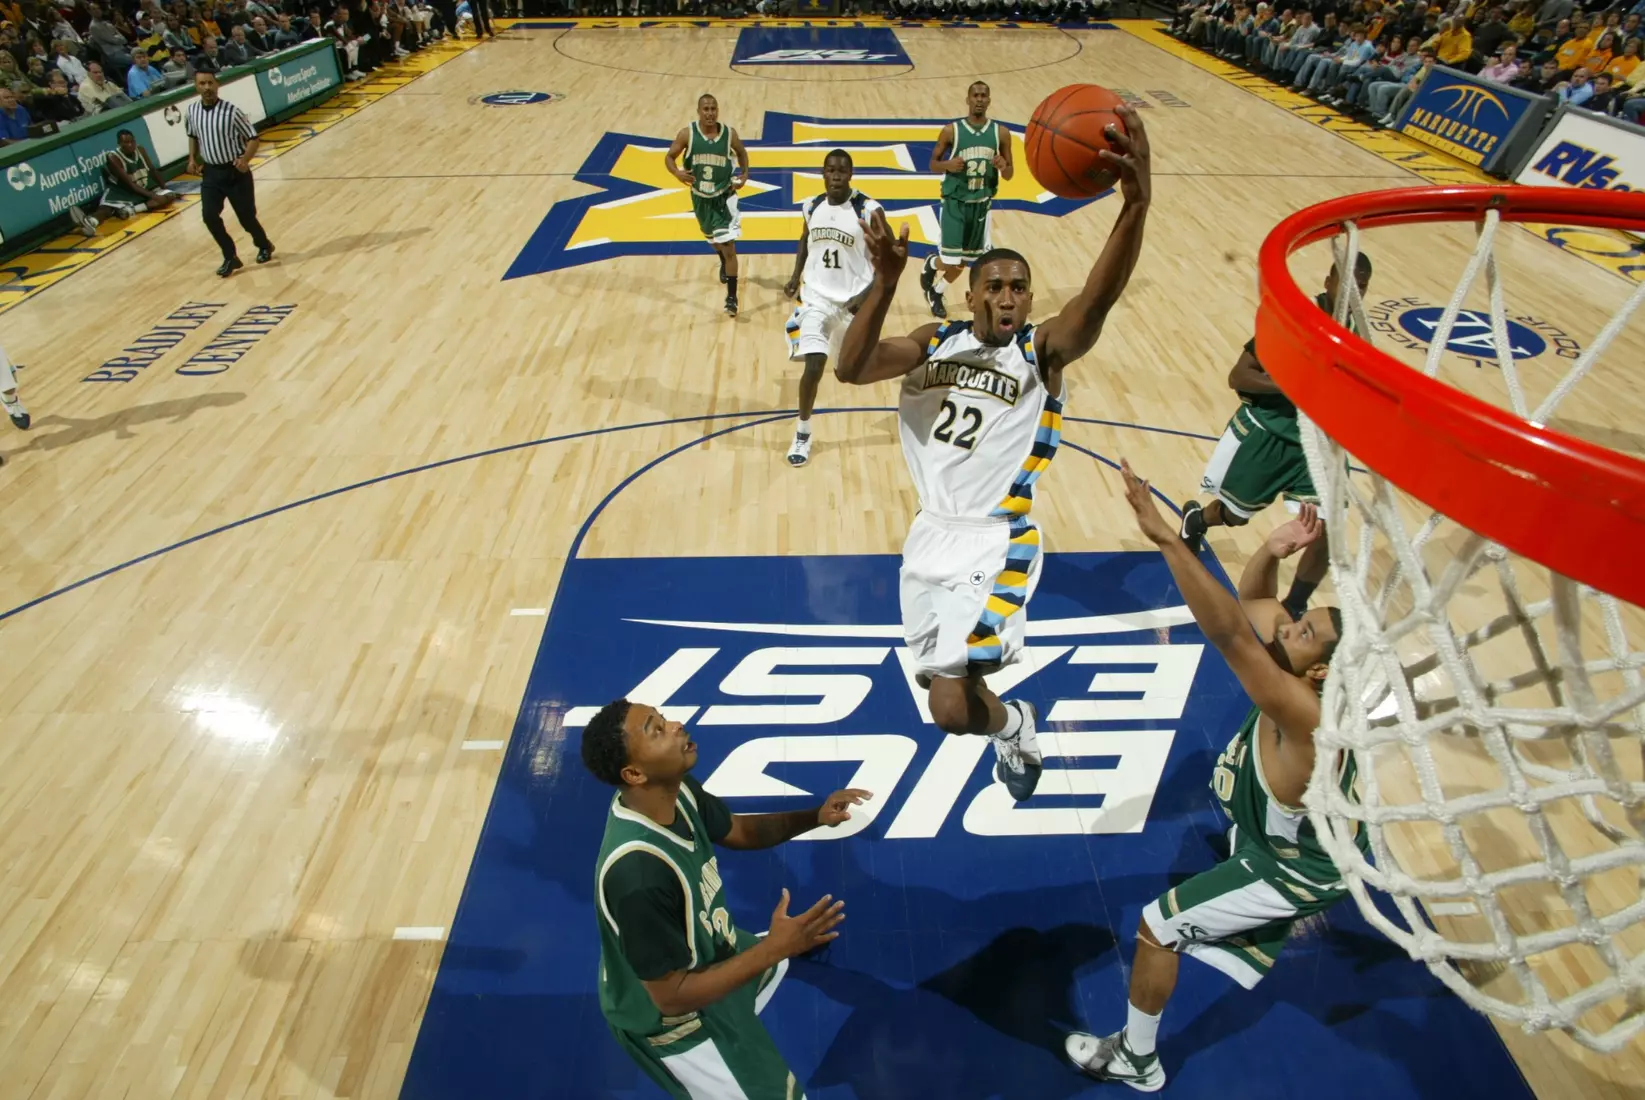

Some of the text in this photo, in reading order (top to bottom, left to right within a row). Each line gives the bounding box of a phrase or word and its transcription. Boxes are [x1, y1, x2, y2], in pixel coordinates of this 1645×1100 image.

[1409, 107, 1498, 153] MARQUETTE
[39, 164, 79, 191] Aurora
[78, 149, 109, 176] Sport
[702, 166, 713, 180] 3
[966, 160, 987, 177] 24
[48, 181, 99, 215] Medicine
[811, 227, 855, 247] MARQUETTE
[822, 248, 842, 269] 41
[80, 301, 229, 383] BRADLEY
[175, 303, 298, 376] CENTER
[1503, 309, 1582, 360] COUR
[923, 359, 1019, 406] MARQUETTE
[934, 400, 983, 450] 22
[563, 644, 1205, 727] EAST
[702, 730, 1176, 841] BIG
